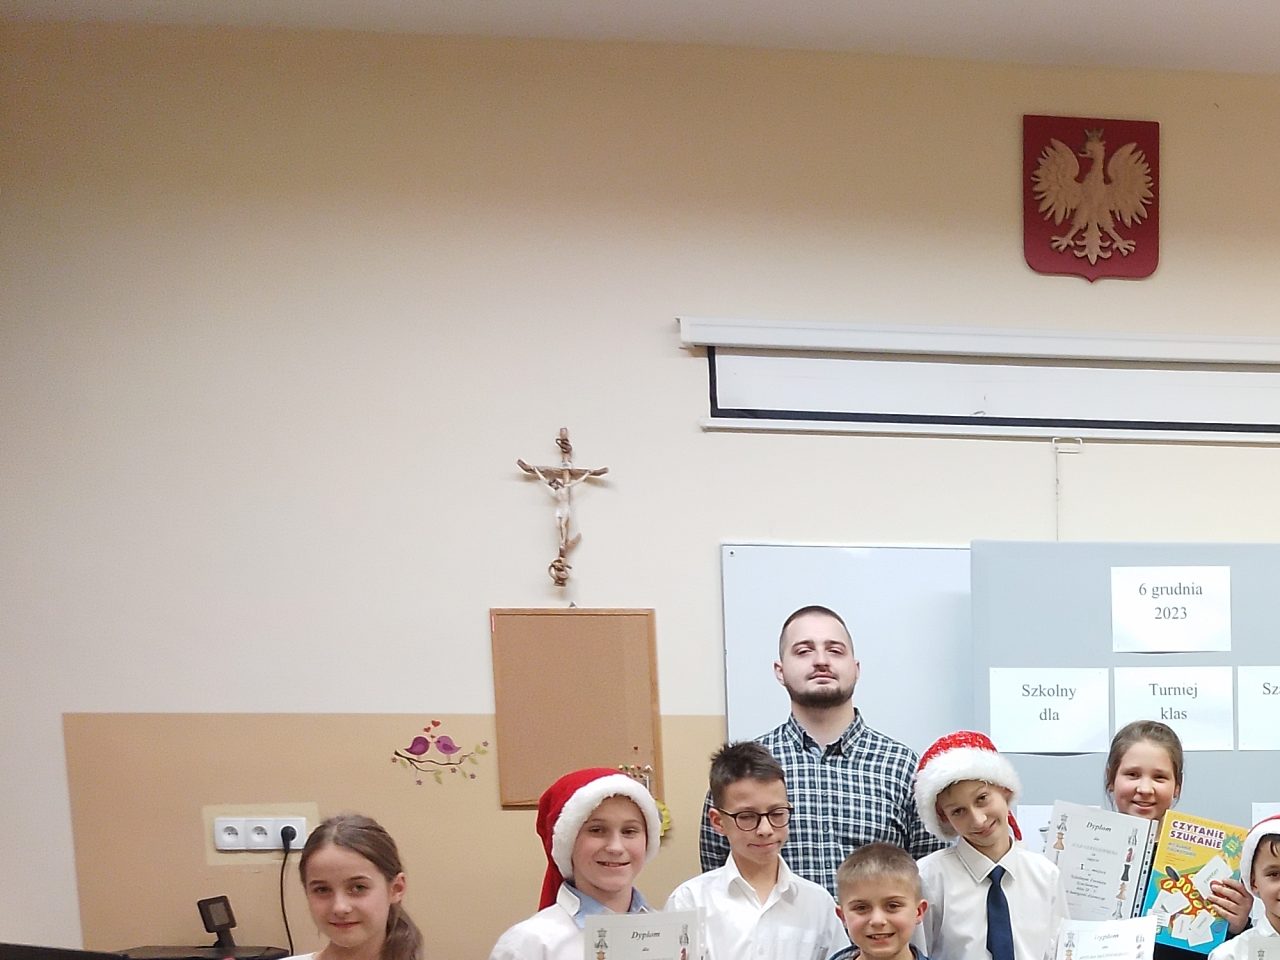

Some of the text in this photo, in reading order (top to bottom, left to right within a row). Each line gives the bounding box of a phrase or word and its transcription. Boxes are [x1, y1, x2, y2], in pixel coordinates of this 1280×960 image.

[1139, 583, 1203, 598] 6 grudnia
[1154, 607, 1188, 620] 2023
[1021, 684, 1077, 700] Szkolny
[1148, 683, 1198, 700] Turniej
[1039, 708, 1060, 722] dla
[1161, 707, 1188, 720] klas
[1087, 821, 1112, 833] Dyplom
[631, 930, 661, 940] Dyplom
